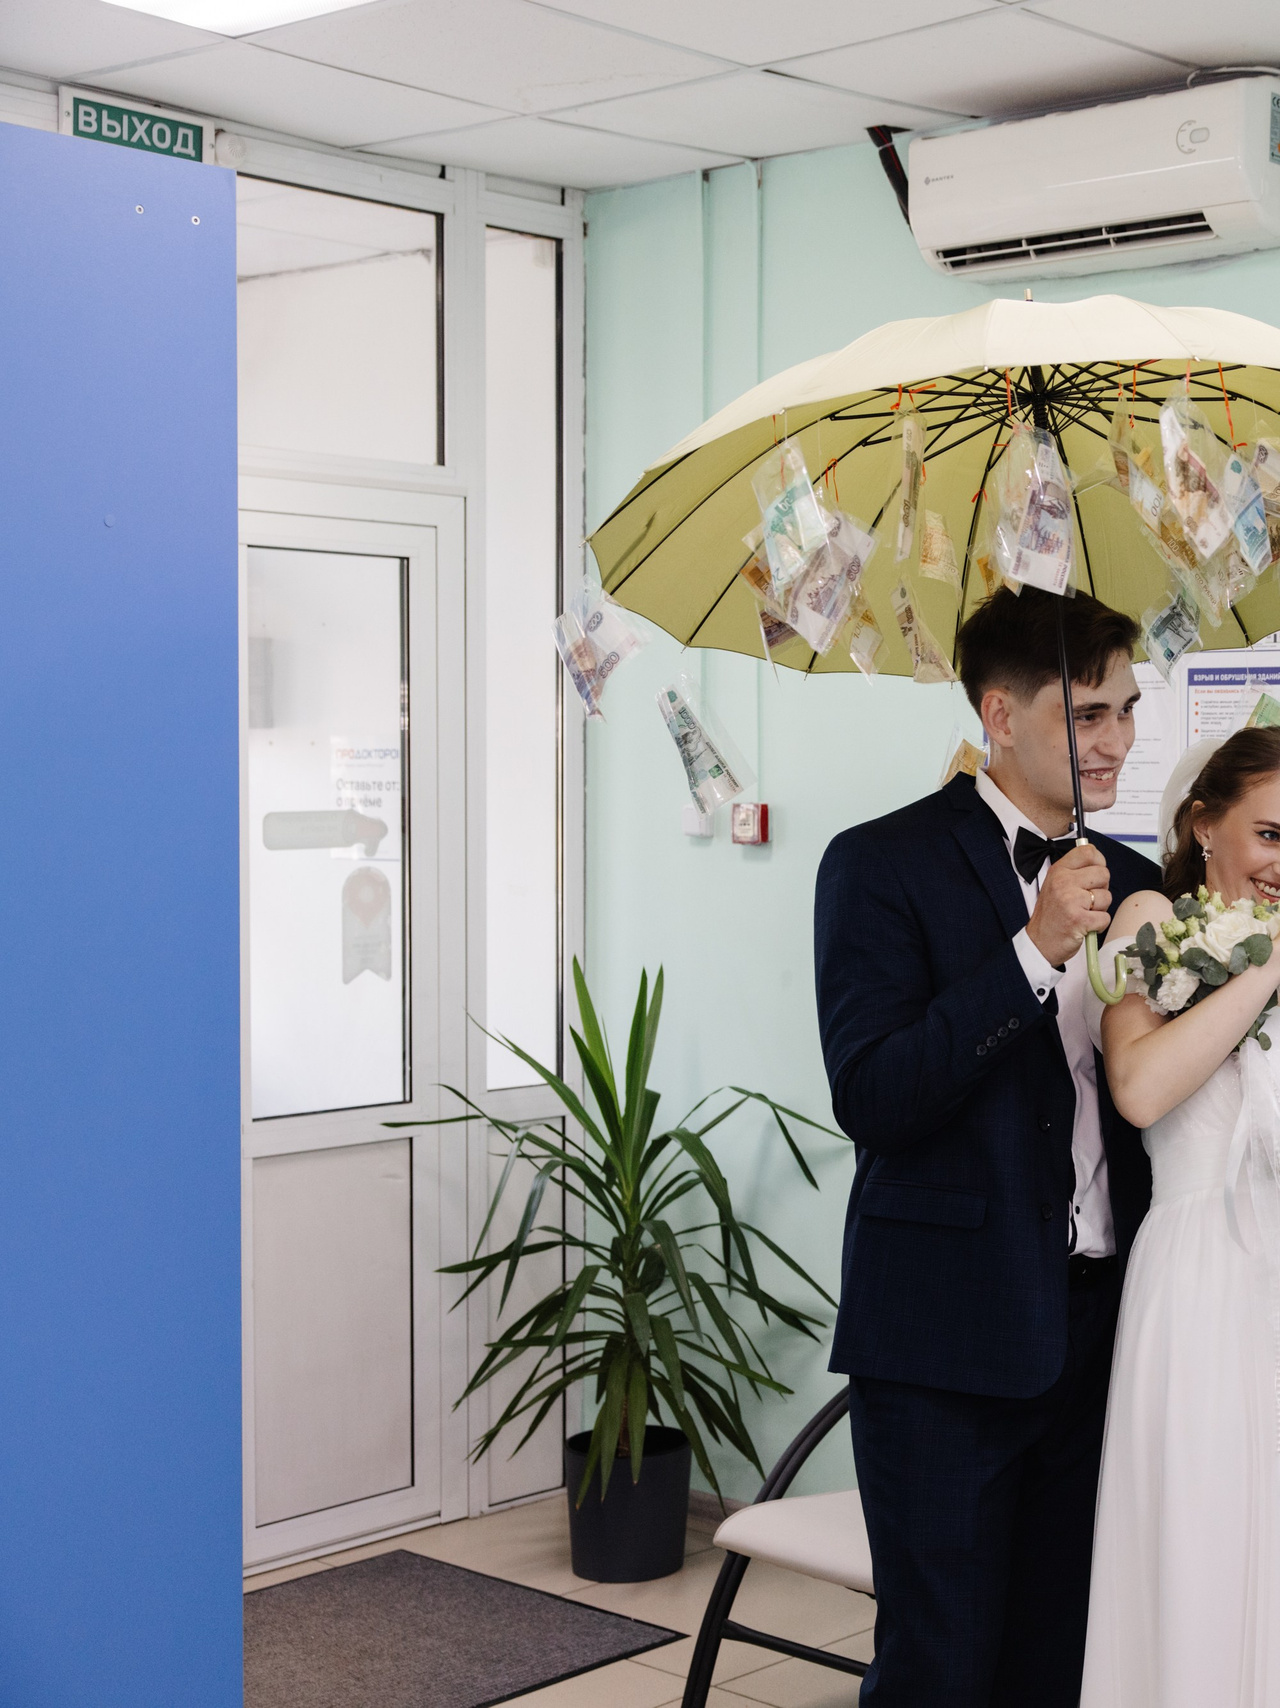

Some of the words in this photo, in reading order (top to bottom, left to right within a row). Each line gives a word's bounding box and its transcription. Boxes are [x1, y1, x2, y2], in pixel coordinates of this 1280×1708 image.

[78, 104, 196, 157] ВЫХОД
[598, 652, 620, 678] 500
[679, 706, 696, 729] 1000
